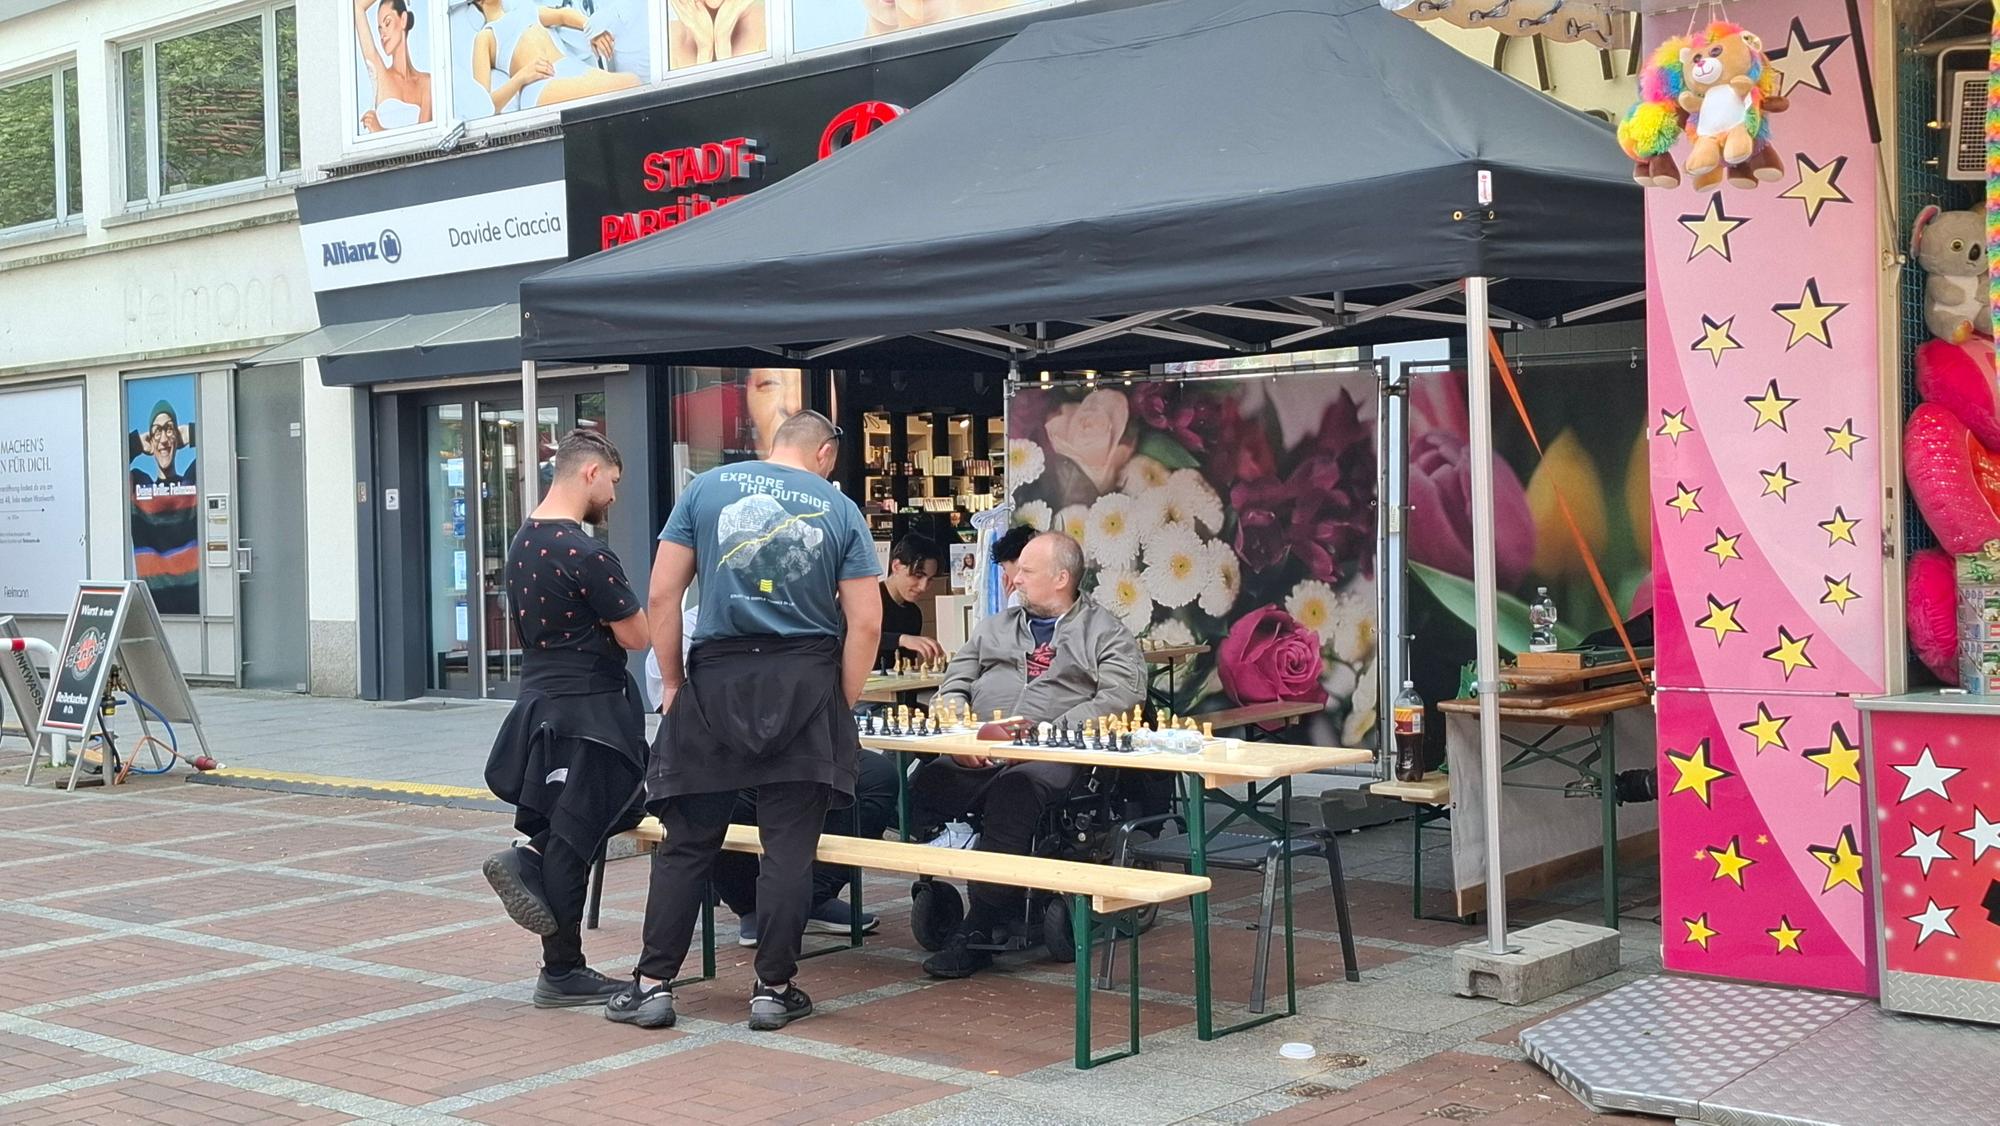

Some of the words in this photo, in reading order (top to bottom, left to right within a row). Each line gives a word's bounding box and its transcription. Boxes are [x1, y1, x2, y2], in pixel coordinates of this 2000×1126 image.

[643, 137, 763, 192] STADT-
[448, 221, 502, 247] Davide
[504, 212, 561, 239] Ciaccia
[321, 242, 378, 267] Allianz
[8, 456, 26, 473] FÜR
[27, 456, 52, 473] DICH.
[720, 472, 785, 490] EXPLORE
[739, 481, 766, 496] THE
[771, 488, 831, 512] OUTSIDE
[81, 604, 99, 617] Wurst
